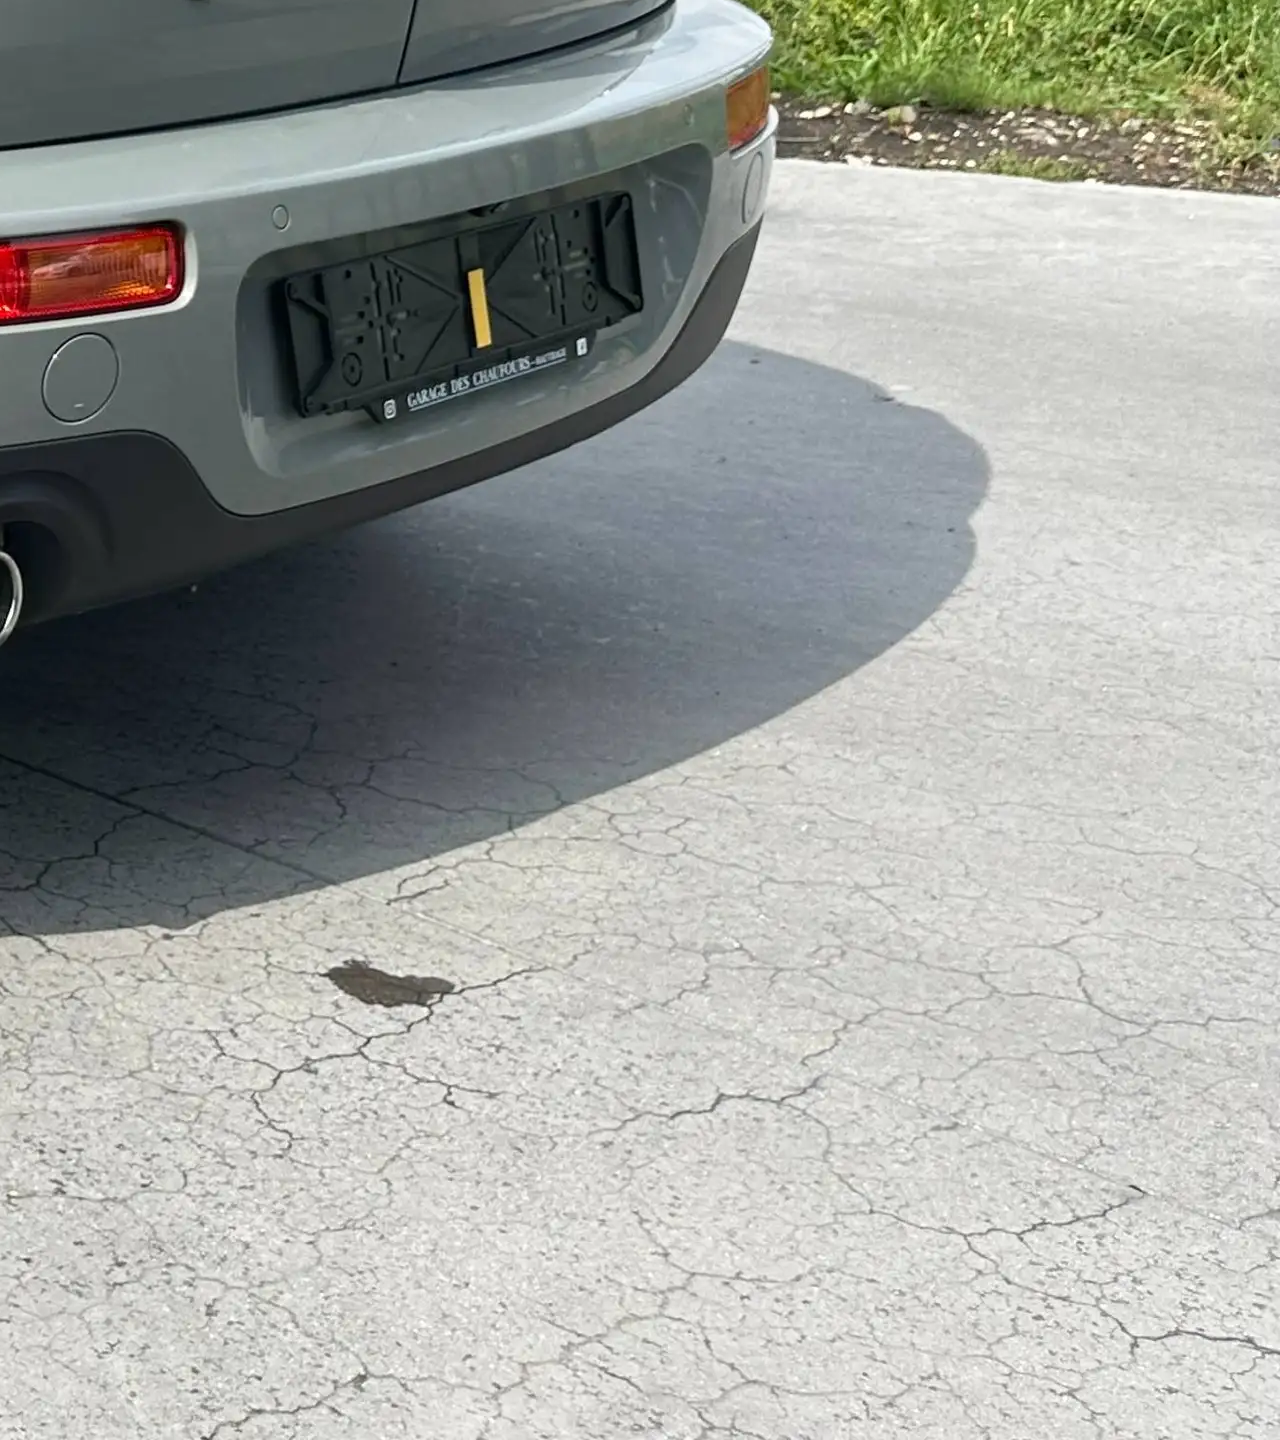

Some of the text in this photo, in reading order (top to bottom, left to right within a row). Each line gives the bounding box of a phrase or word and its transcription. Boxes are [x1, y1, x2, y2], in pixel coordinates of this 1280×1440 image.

[407, 382, 448, 408] GARAGE
[451, 375, 470, 394] DES
[473, 356, 531, 386] CHAUFOURS
